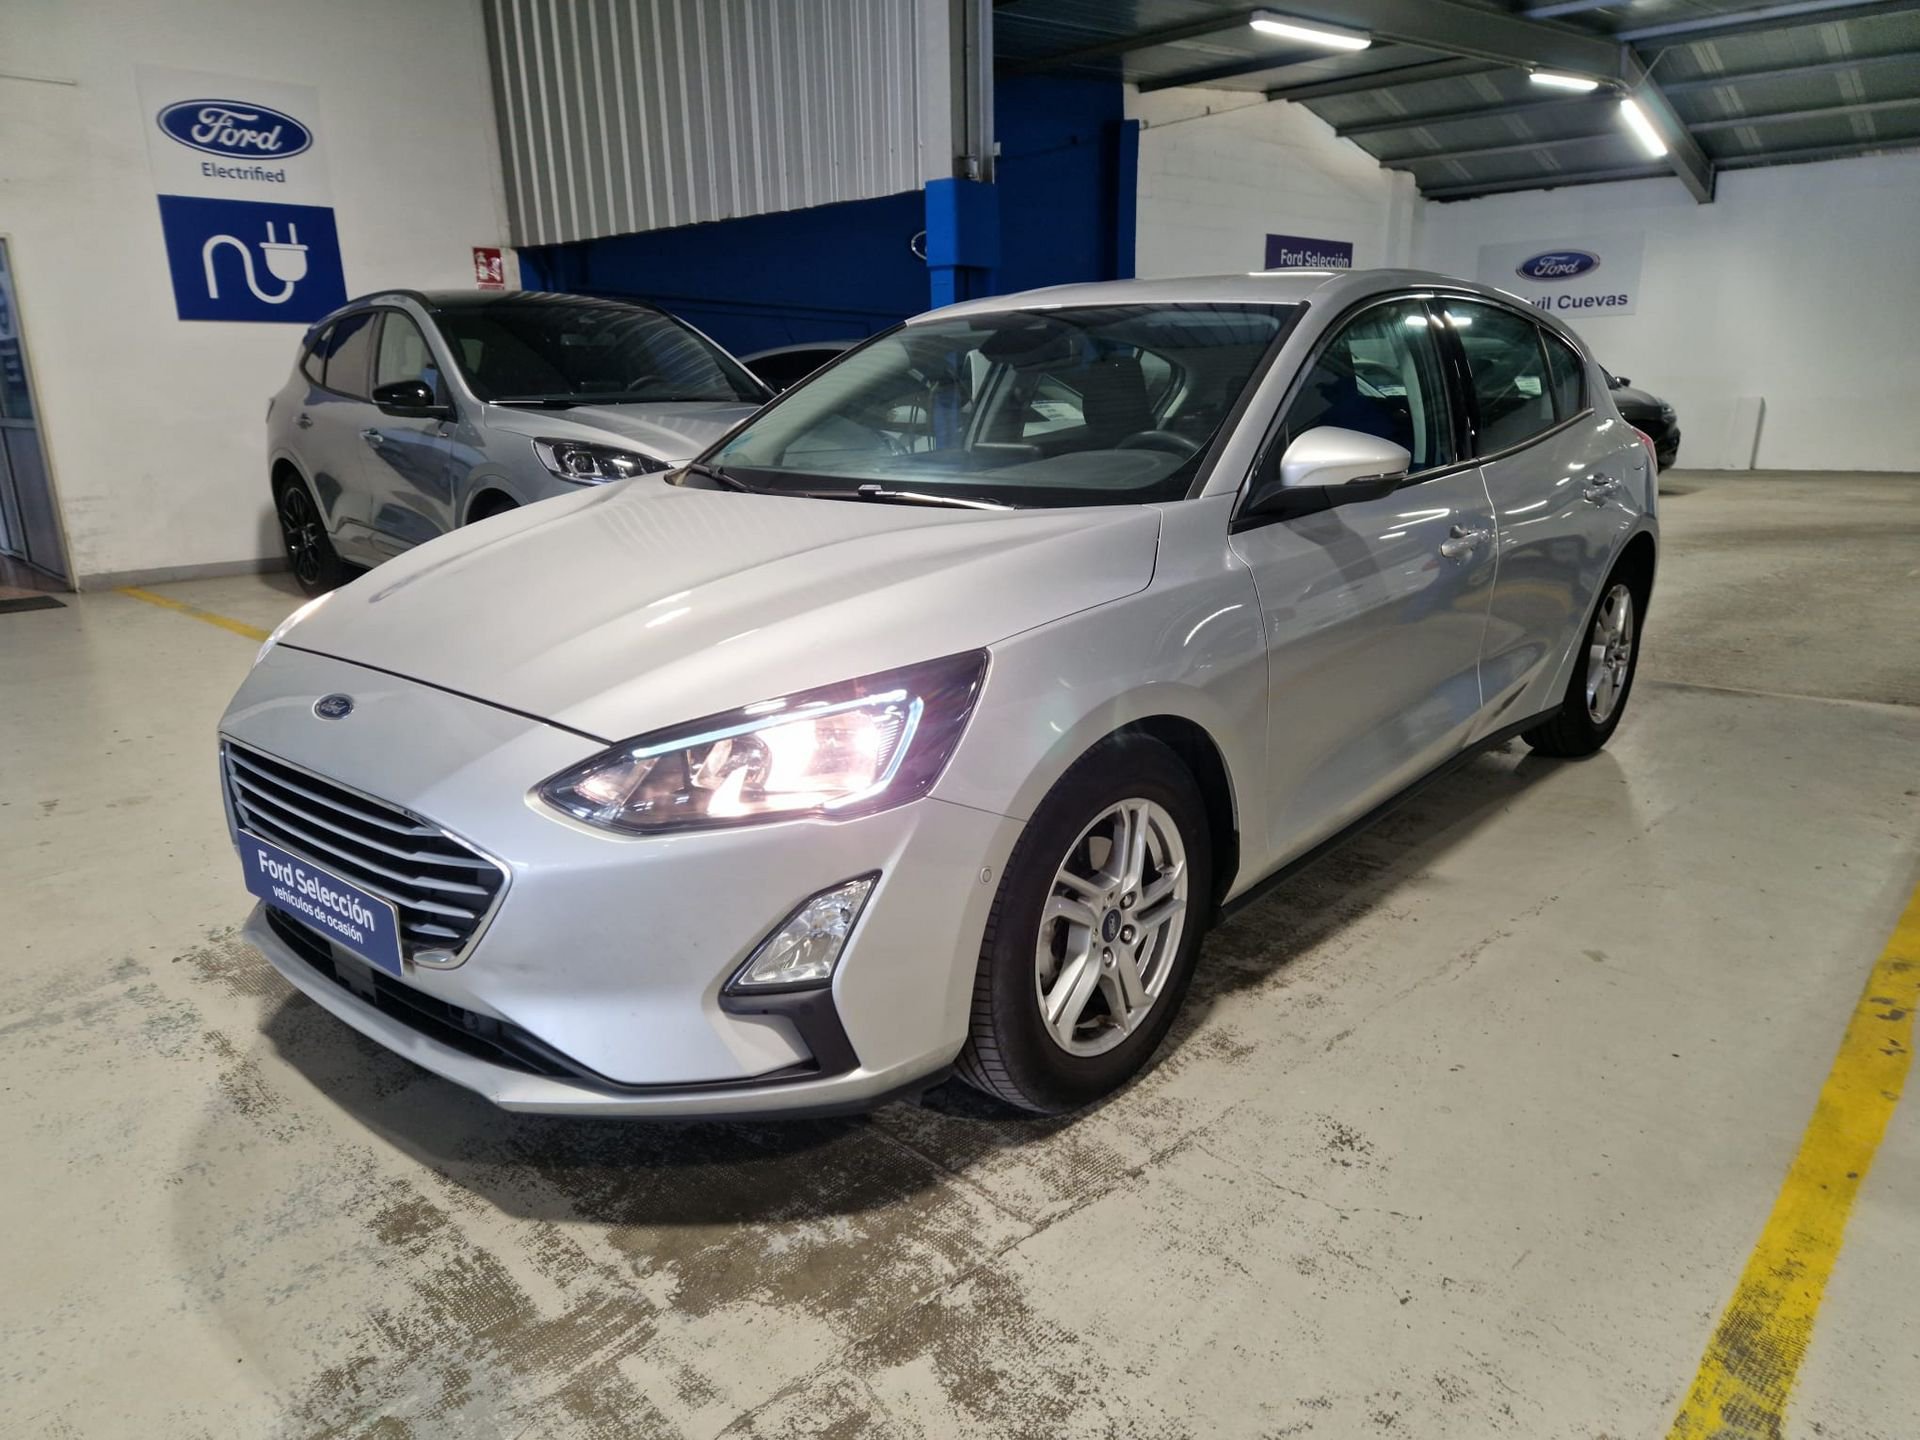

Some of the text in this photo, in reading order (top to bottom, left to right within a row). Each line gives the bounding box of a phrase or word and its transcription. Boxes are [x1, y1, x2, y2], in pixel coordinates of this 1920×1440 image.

[191, 107, 283, 151] Ford
[201, 161, 286, 183] Electrified
[1280, 248, 1350, 269] Ford Selección
[1534, 255, 1580, 276] Ford
[1557, 293, 1629, 310] Cuevas
[257, 849, 375, 932] Ford Selección
[272, 885, 364, 945] vehículos de ocasión
